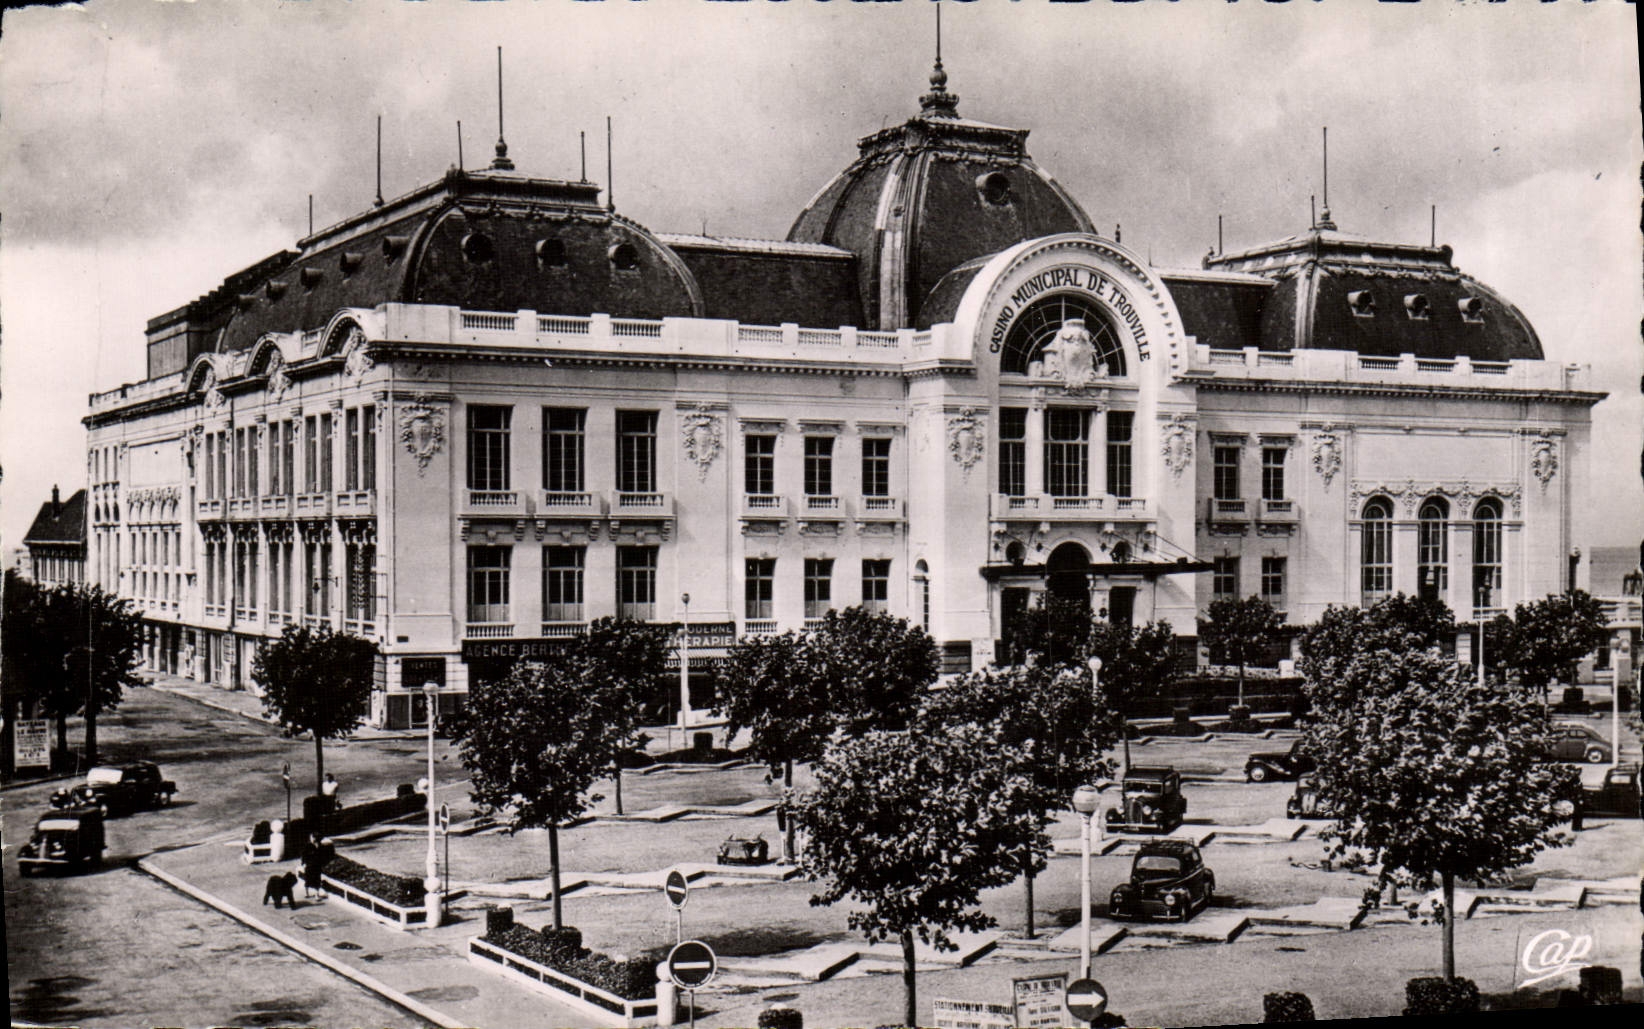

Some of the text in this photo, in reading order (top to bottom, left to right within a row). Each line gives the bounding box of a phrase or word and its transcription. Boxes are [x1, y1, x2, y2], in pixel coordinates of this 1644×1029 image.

[989, 268, 1151, 363] CASINO MUNICIPAL DE TROUVILLE
[465, 644, 516, 658] AGENCE
